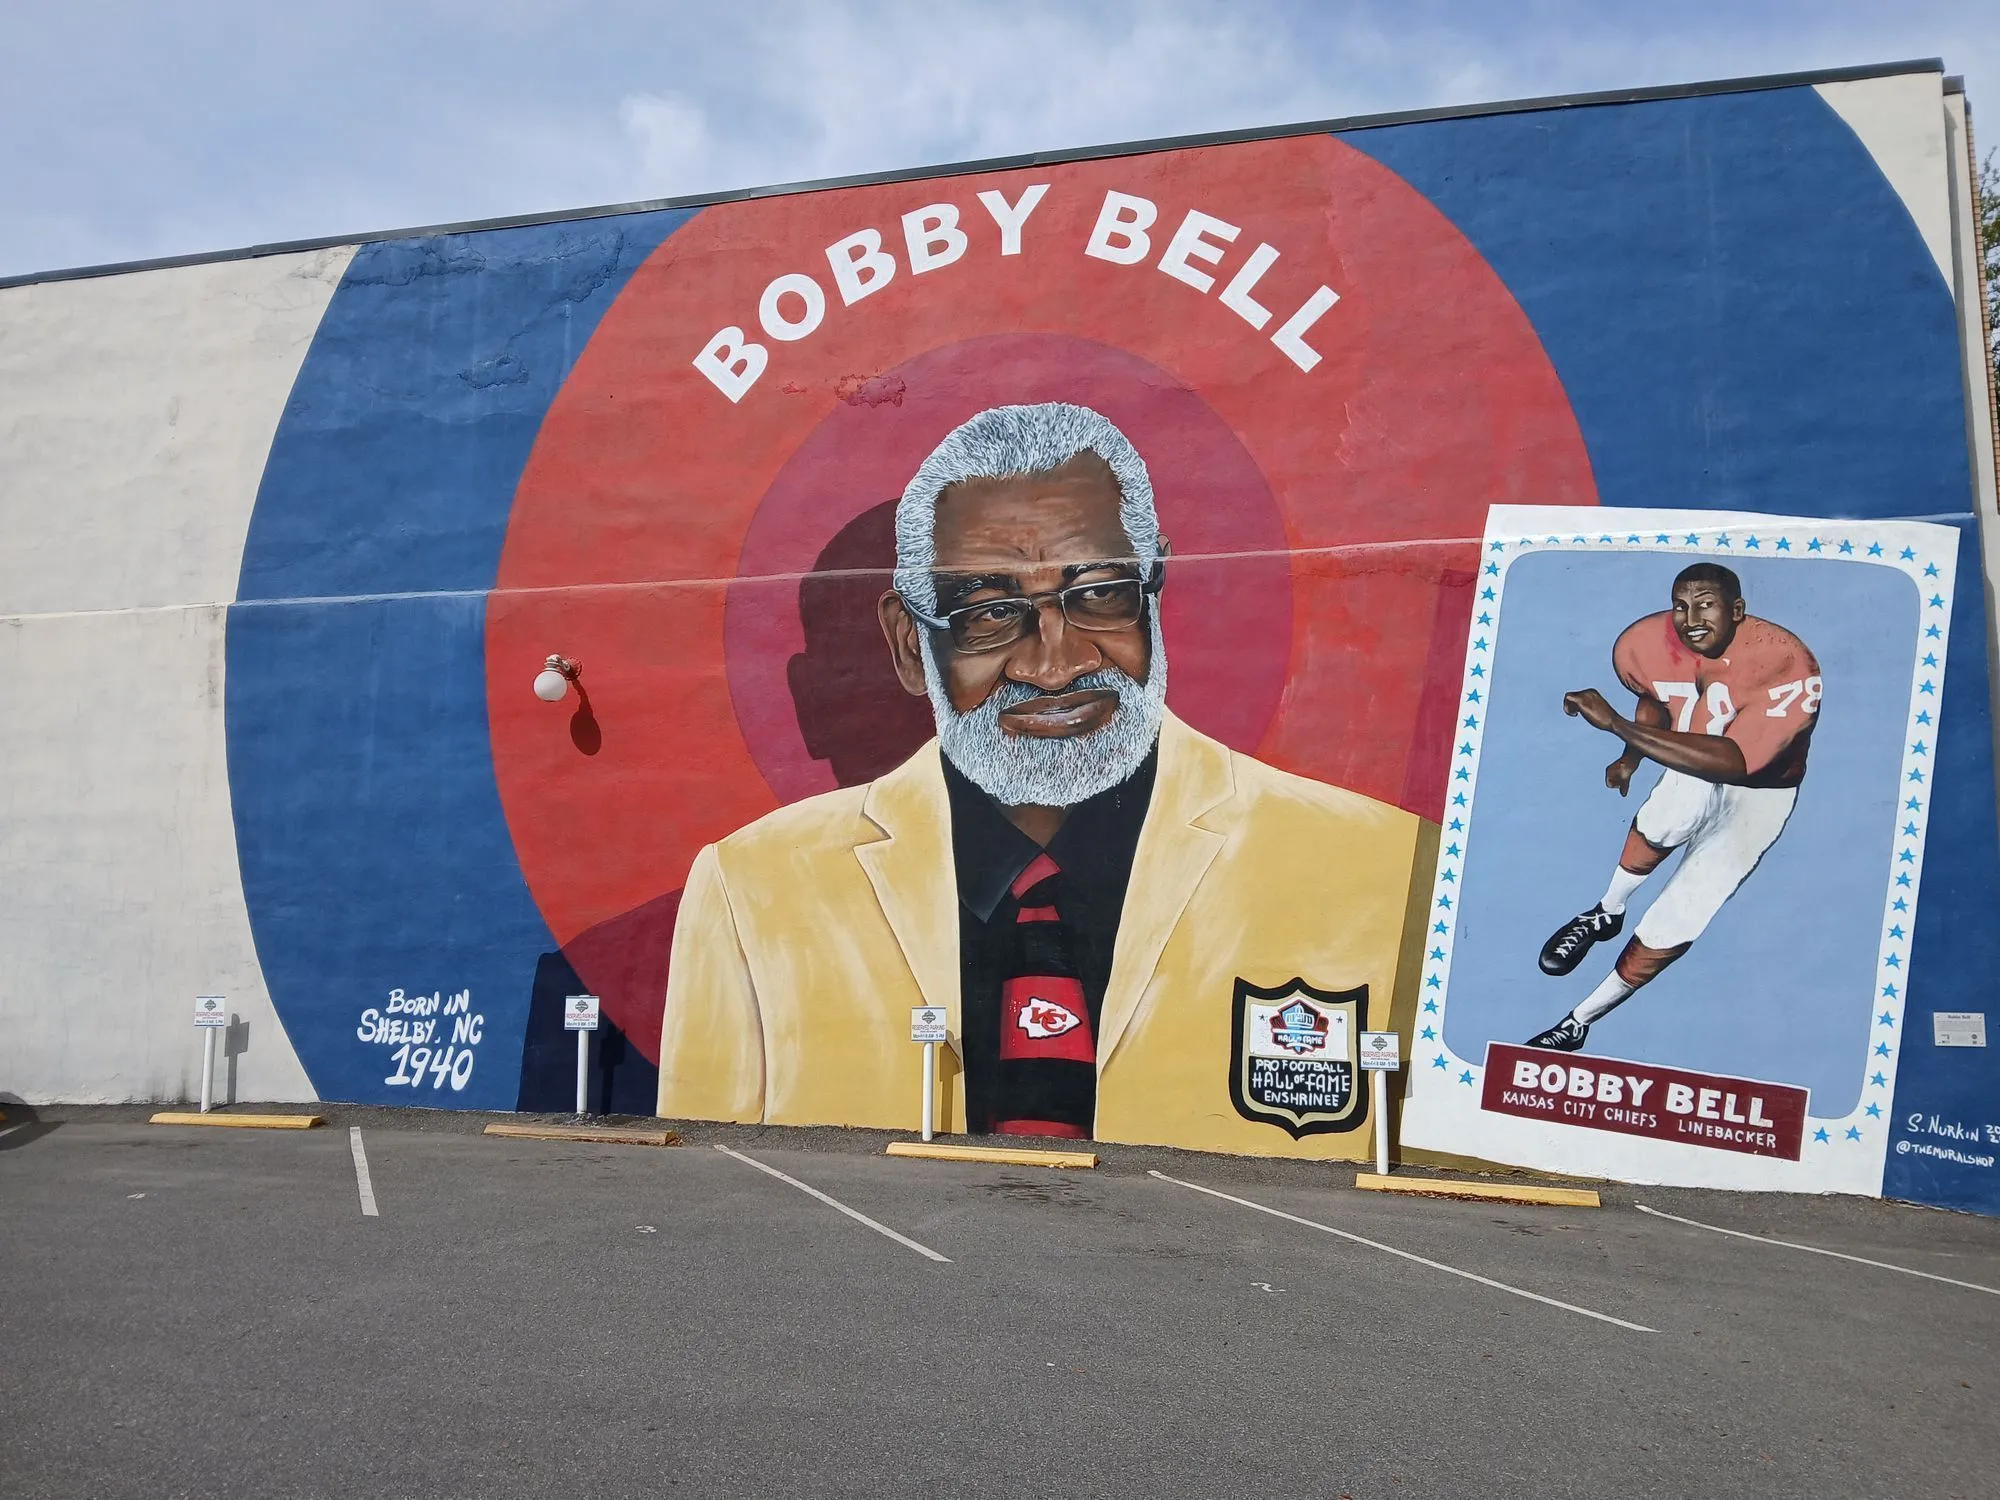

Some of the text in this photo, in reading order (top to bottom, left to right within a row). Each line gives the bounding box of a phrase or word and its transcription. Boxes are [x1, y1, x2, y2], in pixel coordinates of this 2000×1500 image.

[692, 184, 1340, 403] BOBBY BELL
[1652, 681, 1737, 736] 78
[1766, 676, 1822, 717] 78
[451, 1012, 485, 1045] NC
[1030, 1006, 1068, 1033] KC
[384, 1043, 474, 1091] 1940
[1251, 1071, 1351, 1094] HALL OF FAME
[1255, 1059, 1345, 1074] PRO FOOTBALL
[1264, 1089, 1340, 1108] ENSHRINEE
[1512, 1060, 1774, 1129] BOBBY BELL
[1502, 1091, 1776, 1149] KANSAS CITY CHIEFS LINEBACKER
[1906, 1112, 1925, 1133] S.
[1896, 1140, 1995, 1168] @THEMURALSHOP
